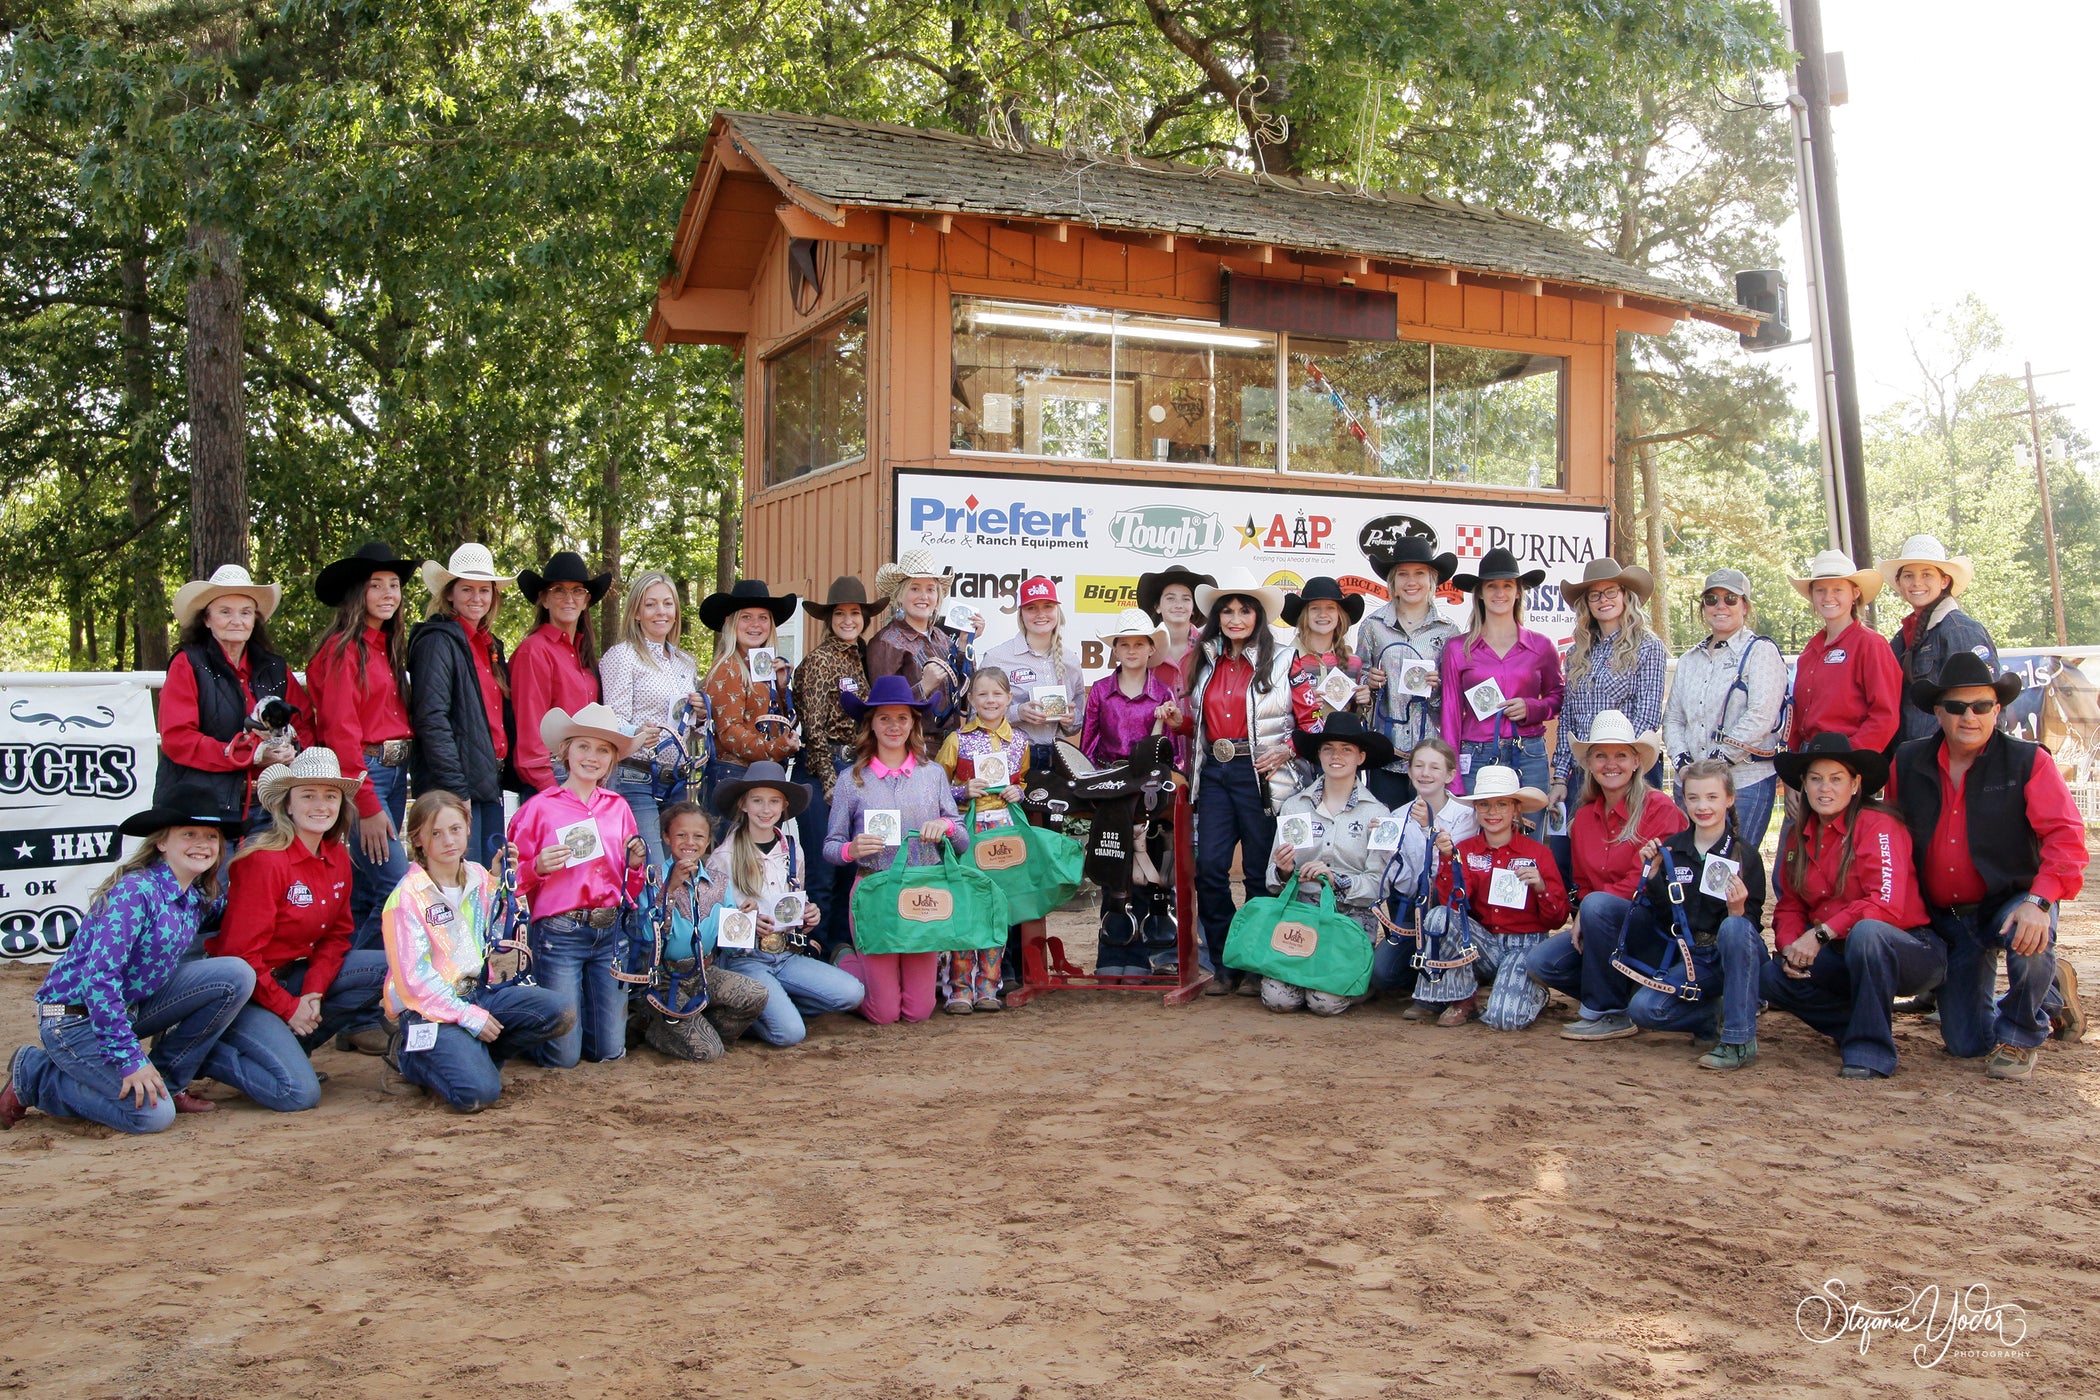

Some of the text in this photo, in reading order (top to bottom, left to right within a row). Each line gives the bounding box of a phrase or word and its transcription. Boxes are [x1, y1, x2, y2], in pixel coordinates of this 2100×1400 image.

[910, 495, 1087, 538] Priefert
[920, 531, 1089, 550] Rodeo & Ranch Equipment
[1253, 555, 1275, 563] Keeping
[942, 566, 1063, 615] rang
[1083, 584, 1138, 604] BigTe
[1337, 577, 1381, 595] CIRCLE
[1529, 613, 1549, 623] best
[1102, 831, 1120, 840] 2023
[51, 831, 114, 861] HAY
[1094, 848, 1126, 860] CHAMPION
[1100, 840, 1121, 850] CLINIC
[24, 879, 57, 897] OK
[1643, 979, 1673, 992] CLINIC
